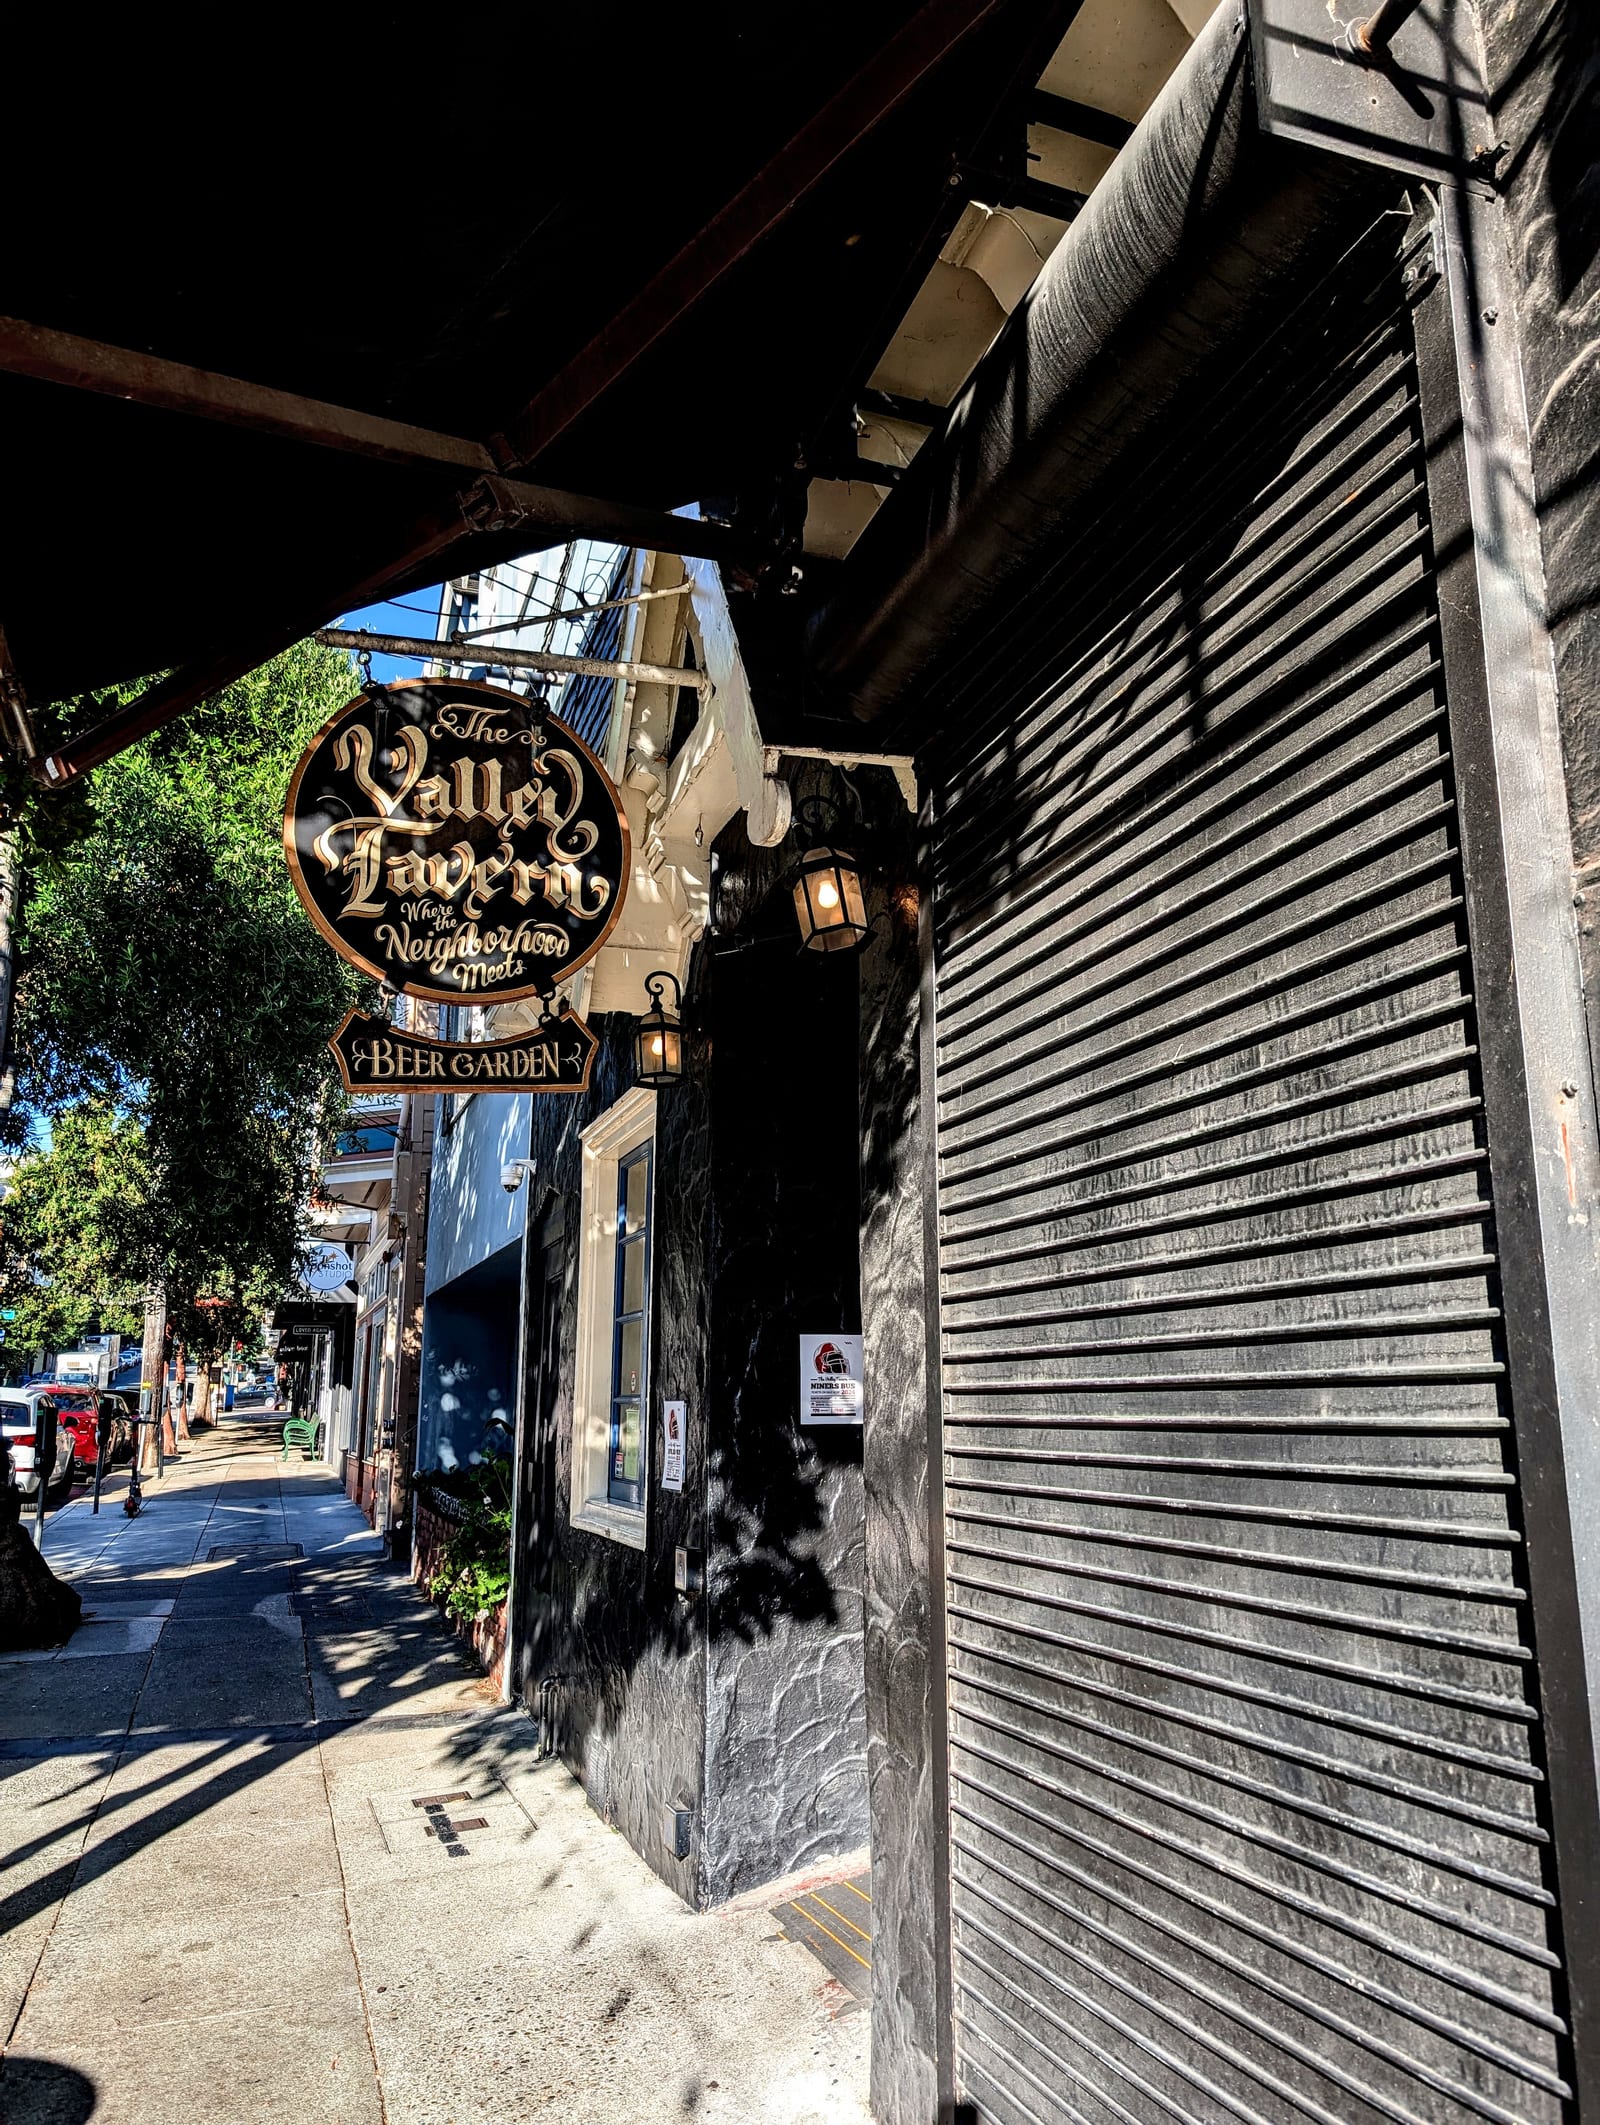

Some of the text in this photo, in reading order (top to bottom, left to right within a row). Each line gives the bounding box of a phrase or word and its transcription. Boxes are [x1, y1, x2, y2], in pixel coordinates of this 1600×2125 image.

[430, 703, 547, 746] The
[334, 724, 600, 864] Valley
[314, 798, 610, 921] Tavern
[400, 898, 455, 924] Where
[432, 916, 459, 932] the
[375, 919, 570, 976] Neighborhood
[452, 952, 526, 991] Meets
[370, 1038, 560, 1080] BEER GARDEN
